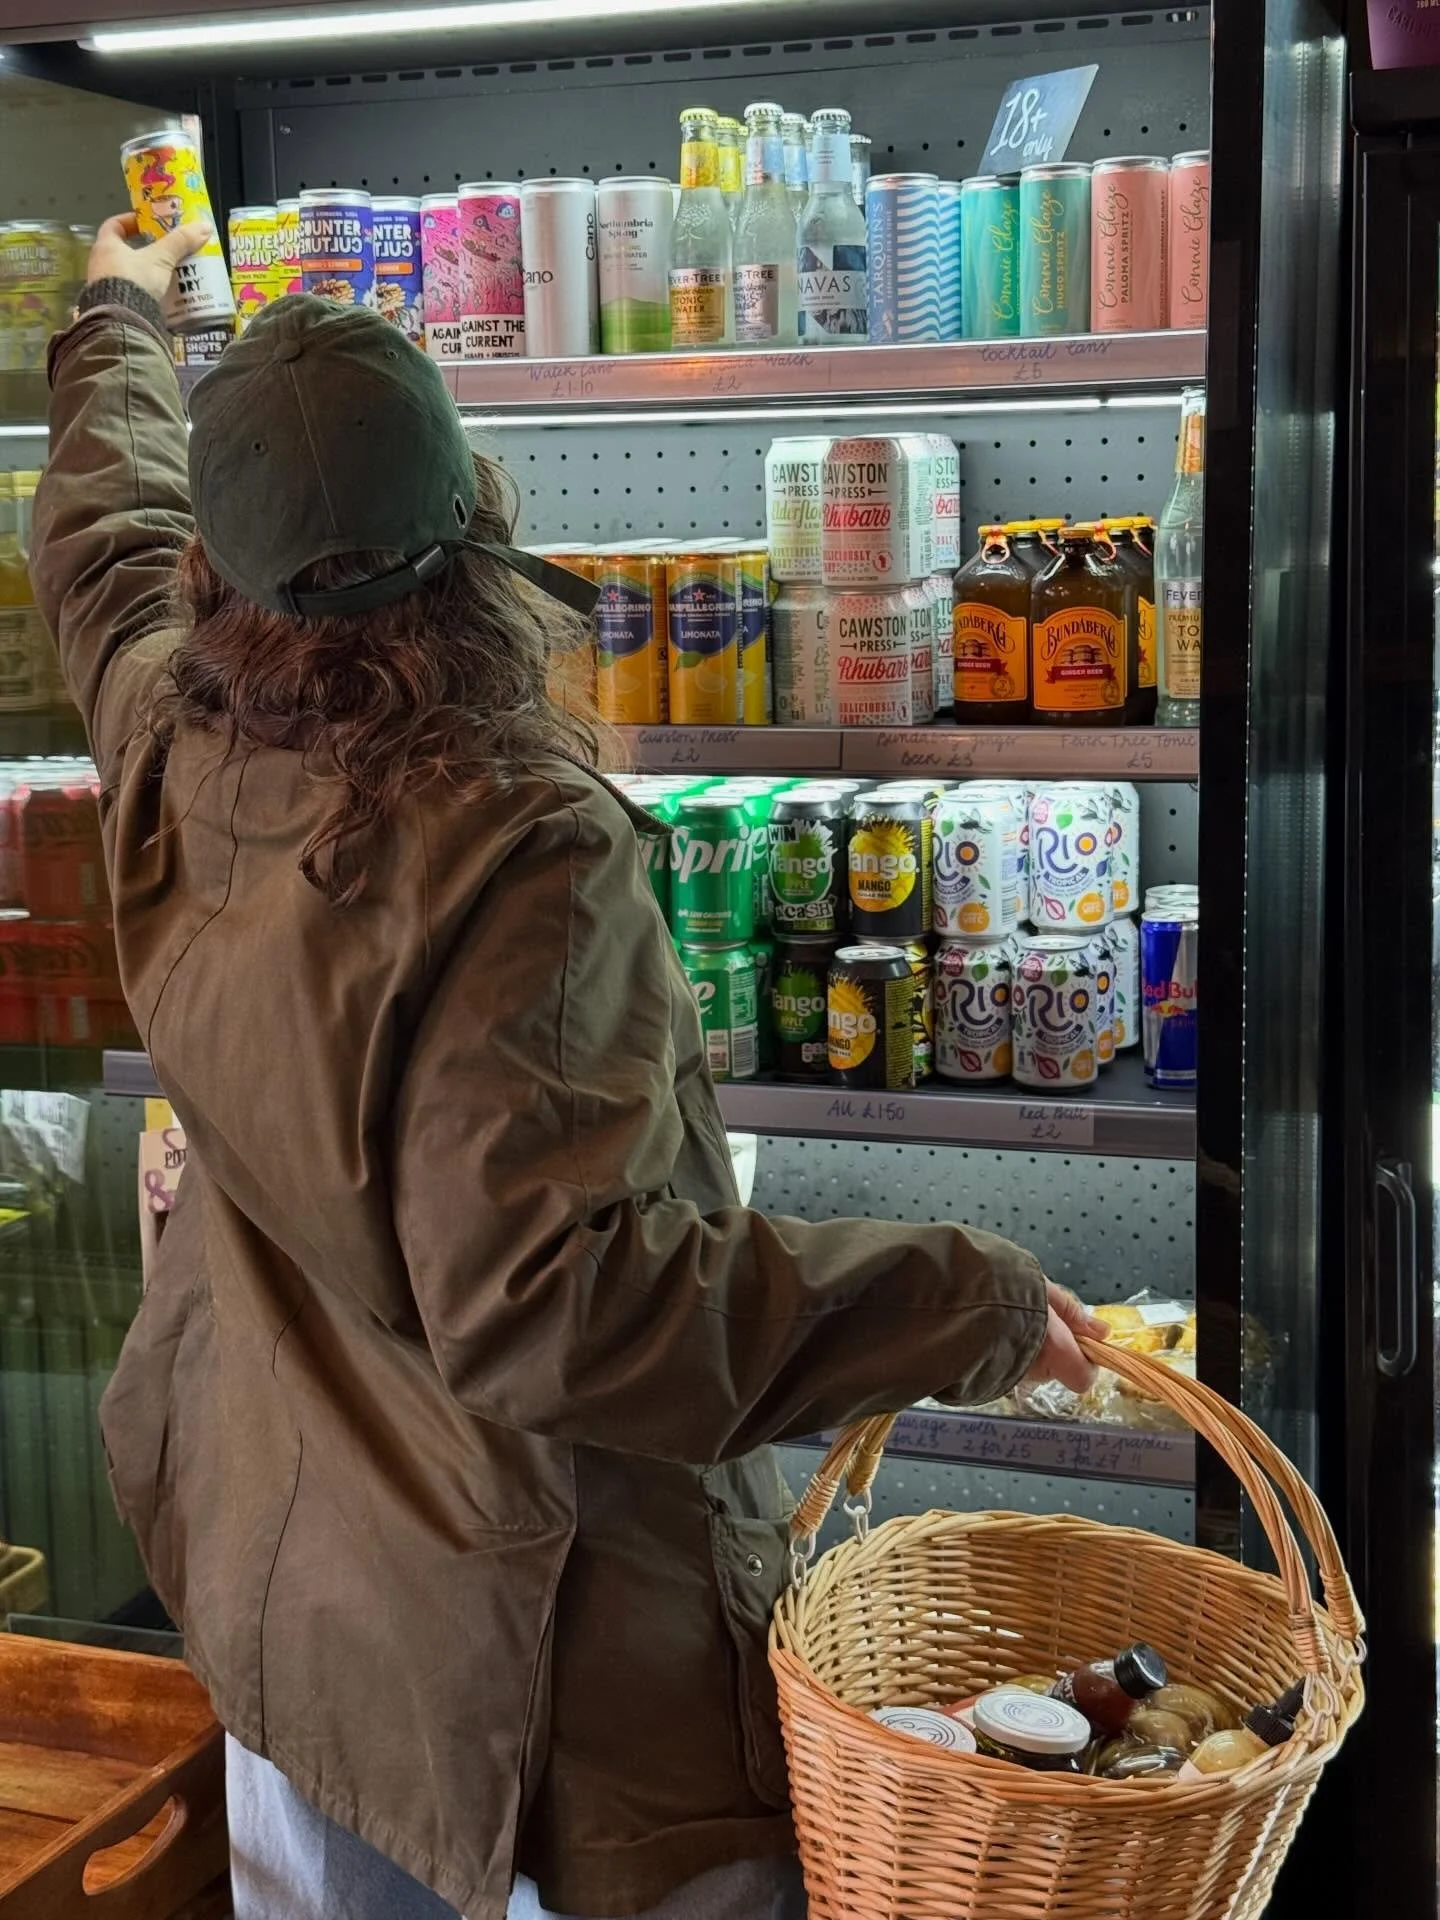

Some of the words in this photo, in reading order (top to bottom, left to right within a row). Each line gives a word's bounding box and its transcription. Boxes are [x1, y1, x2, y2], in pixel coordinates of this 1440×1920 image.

[990, 88, 1048, 156] 18+
[1022, 134, 1054, 160] only
[1097, 183, 1129, 239] Glaze
[372, 223, 411, 240] NTER
[585, 212, 595, 261] Cano
[1121, 211, 1129, 252] SPRITZ
[1056, 231, 1065, 272] SPRITZ
[175, 263, 197, 279] TRY
[524, 270, 553, 284] ano
[1096, 242, 1119, 310] Connie
[1121, 256, 1129, 303] PALOMA
[1181, 238, 1204, 305] Connie
[178, 279, 201, 294] DRY
[1056, 275, 1065, 308] HUGO
[461, 319, 499, 332] GAINST
[504, 320, 525, 333] THE
[466, 335, 514, 348] CURRENT
[1013, 361, 1042, 381] £5
[713, 374, 743, 392] £2
[772, 463, 819, 483] CAWST
[788, 485, 820, 497] PRESS
[834, 486, 866, 499] PRESS
[823, 503, 891, 528] Rhubarb
[681, 630, 721, 640] LIMONATA
[839, 616, 907, 638] CAWSTON
[859, 639, 892, 653] PRESS
[1041, 615, 1120, 660] BUNDABERG
[837, 655, 909, 682] Rhubarb
[671, 747, 700, 763] £2
[1127, 751, 1154, 769] £5
[770, 826, 797, 841] WIN
[1036, 826, 1098, 874] RIO
[858, 879, 891, 892] MANGO
[1169, 981, 1199, 999] Bul
[1027, 984, 1090, 1032] RIO
[1018, 1105, 1048, 1121] Red
[1031, 1122, 1061, 1140] £2
[1065, 1430, 1092, 1452] egg
[962, 1439, 976, 1453] 2
[980, 1440, 1002, 1457] for
[1006, 1443, 1032, 1460] £5
[1054, 1448, 1067, 1465] 3
[1069, 1450, 1091, 1470] for
[1095, 1453, 1121, 1471] £7
